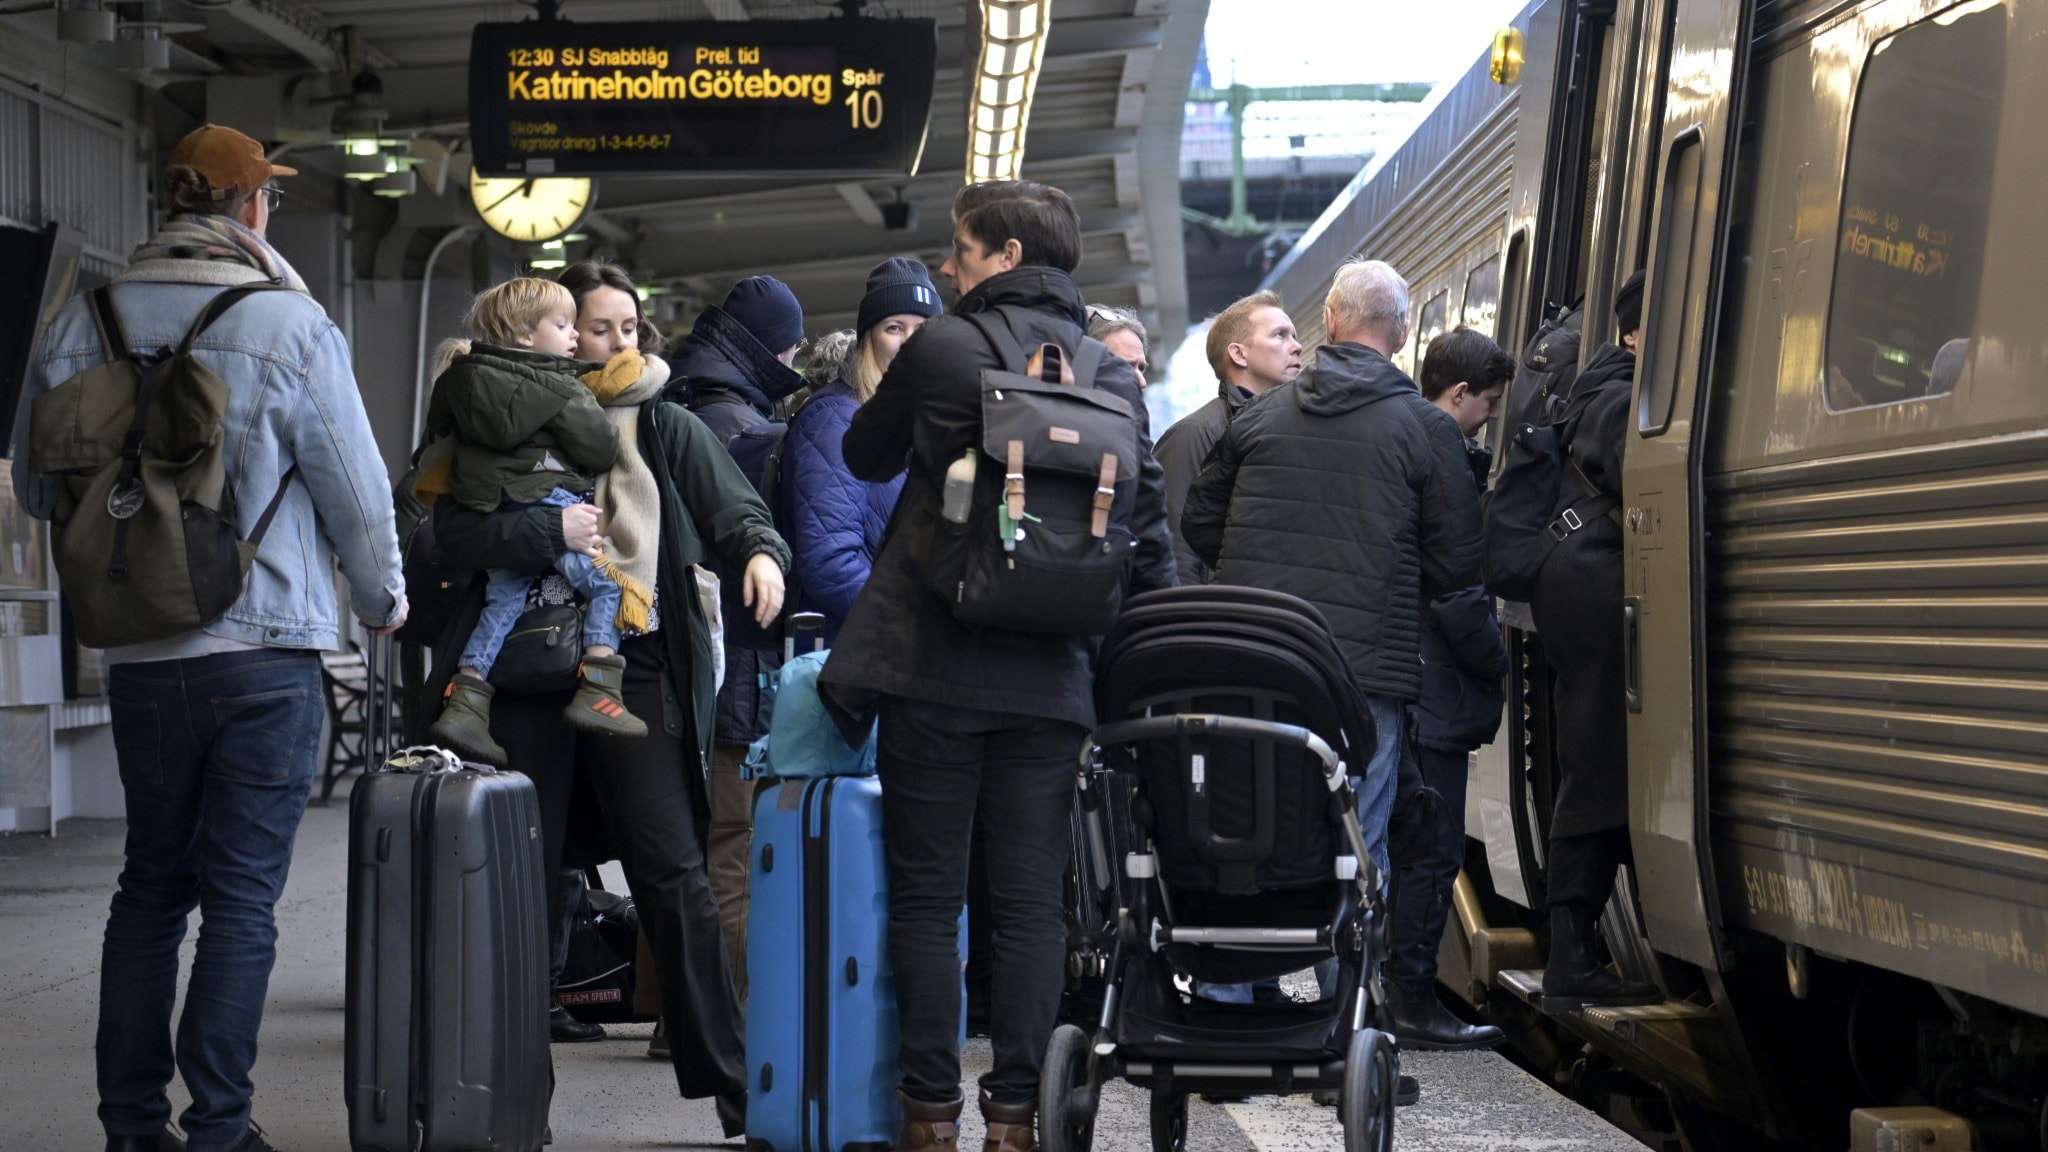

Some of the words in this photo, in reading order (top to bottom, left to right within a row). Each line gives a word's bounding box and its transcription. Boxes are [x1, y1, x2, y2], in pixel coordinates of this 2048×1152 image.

[508, 48, 554, 66] 12:30
[561, 48, 584, 66] SJ
[588, 46, 669, 69] Snabbtåg
[695, 47, 733, 64] Prel.
[738, 47, 759, 64] tid
[508, 69, 686, 100] Katrineholm
[688, 68, 831, 105] Göteborg
[841, 68, 884, 89] Spår
[845, 89, 884, 129] 10
[600, 134, 672, 149] 1-3-4-5-6-7
[560, 993, 589, 1004] TEAM
